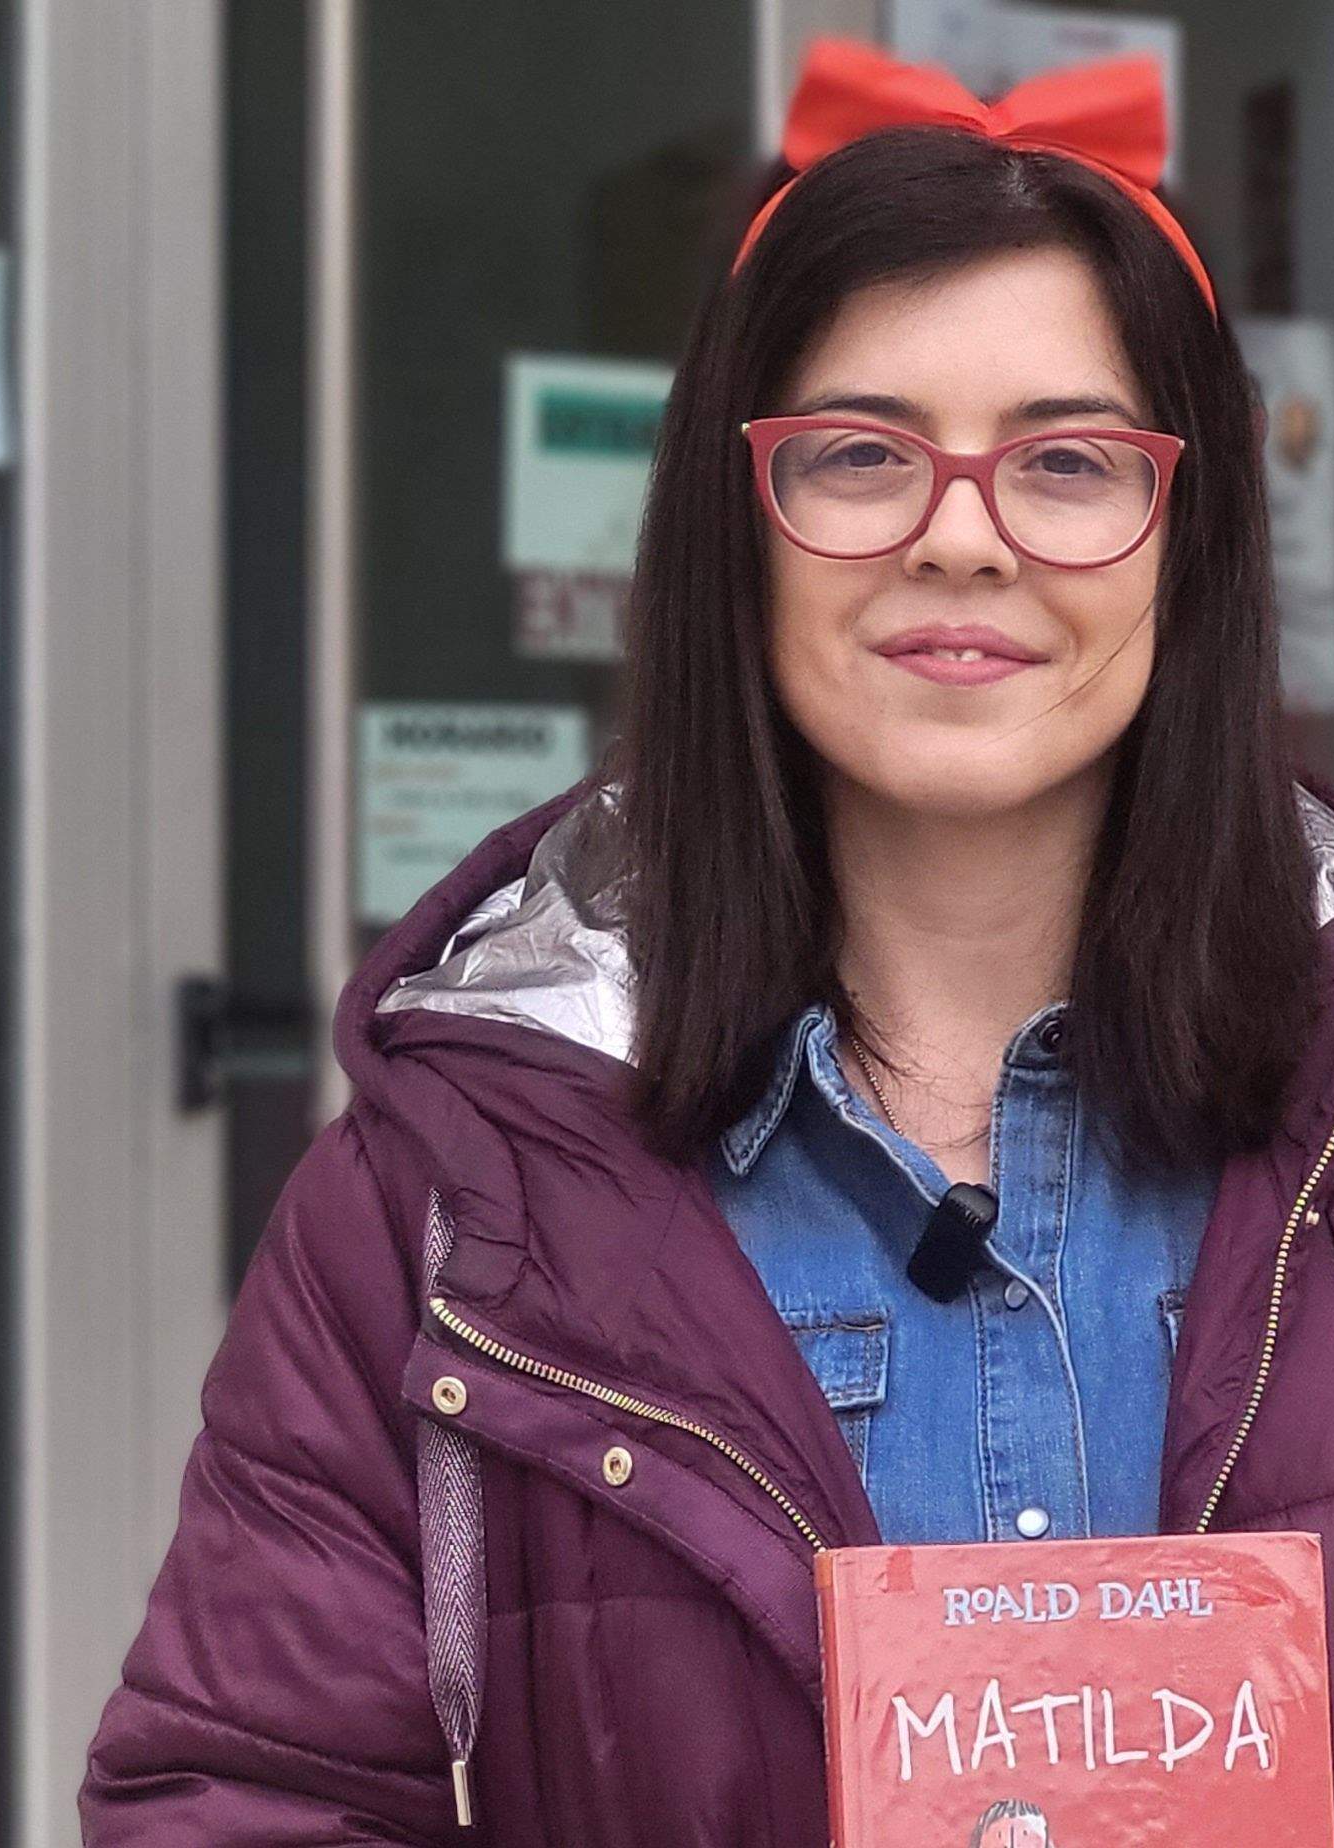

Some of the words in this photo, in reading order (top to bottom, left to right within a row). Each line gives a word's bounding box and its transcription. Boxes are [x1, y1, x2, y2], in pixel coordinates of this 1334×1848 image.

[943, 1581, 1079, 1626] ROALD
[1098, 1578, 1213, 1621] DAHL
[891, 1678, 1271, 1781] MATILDA
